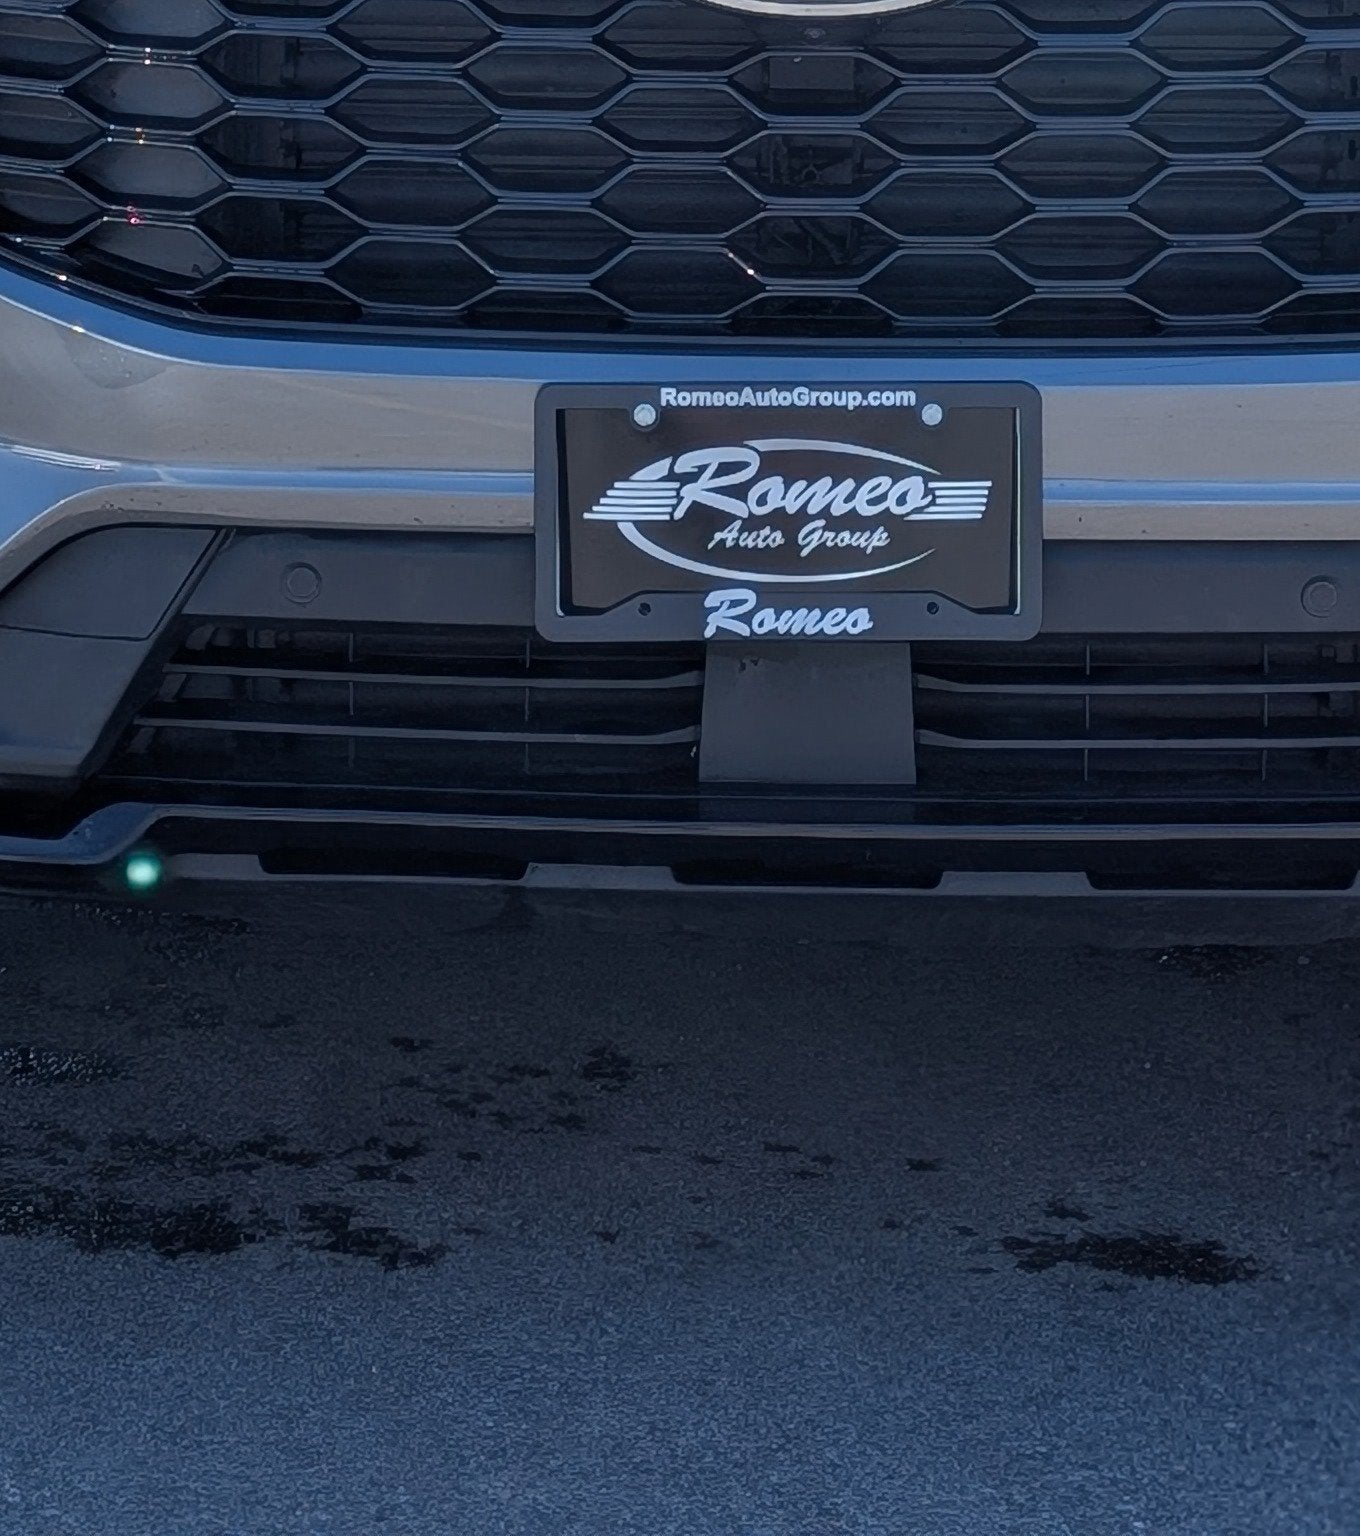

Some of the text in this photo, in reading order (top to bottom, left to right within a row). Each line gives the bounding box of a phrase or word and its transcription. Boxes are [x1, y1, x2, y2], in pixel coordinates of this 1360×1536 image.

[660, 386, 917, 411] RomeoAutoGroup.com
[673, 446, 936, 522] Romeo
[707, 519, 891, 557] Auto Group
[703, 587, 874, 639] Romeo
